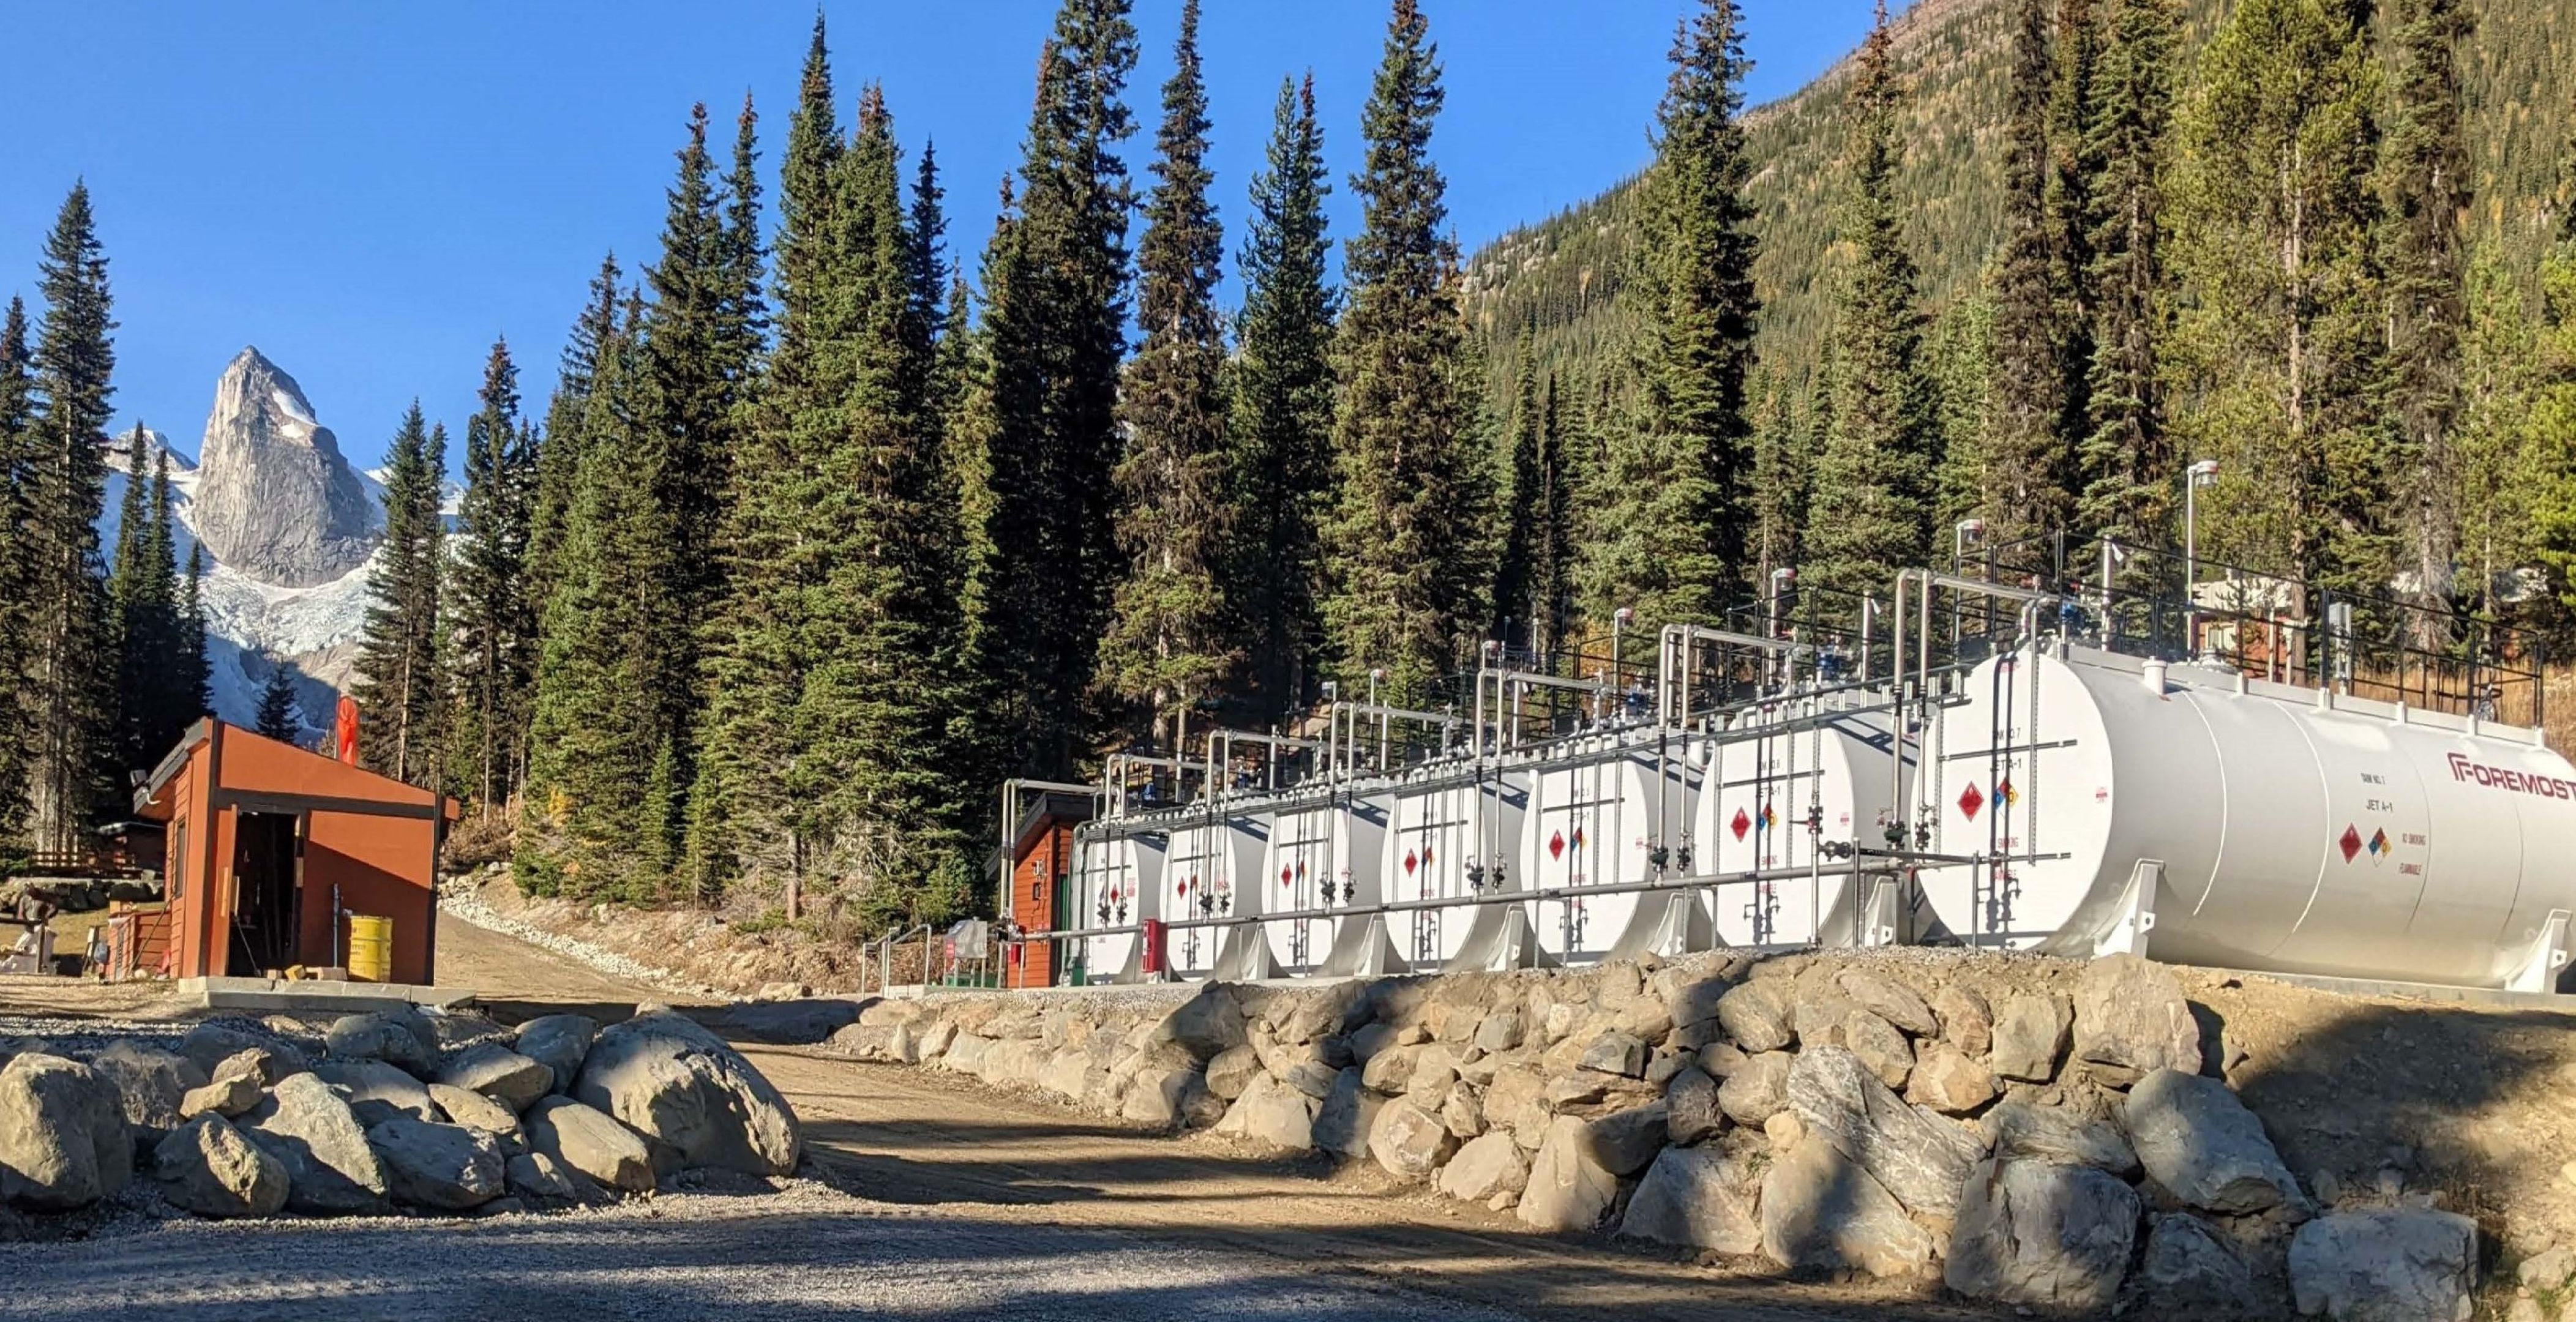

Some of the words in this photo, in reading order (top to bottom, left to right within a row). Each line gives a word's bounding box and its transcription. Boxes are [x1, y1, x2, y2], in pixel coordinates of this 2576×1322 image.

[2447, 752, 2576, 801] FOREMOST
[2365, 799, 2379, 811] JET
[2381, 801, 2393, 812] A-1
